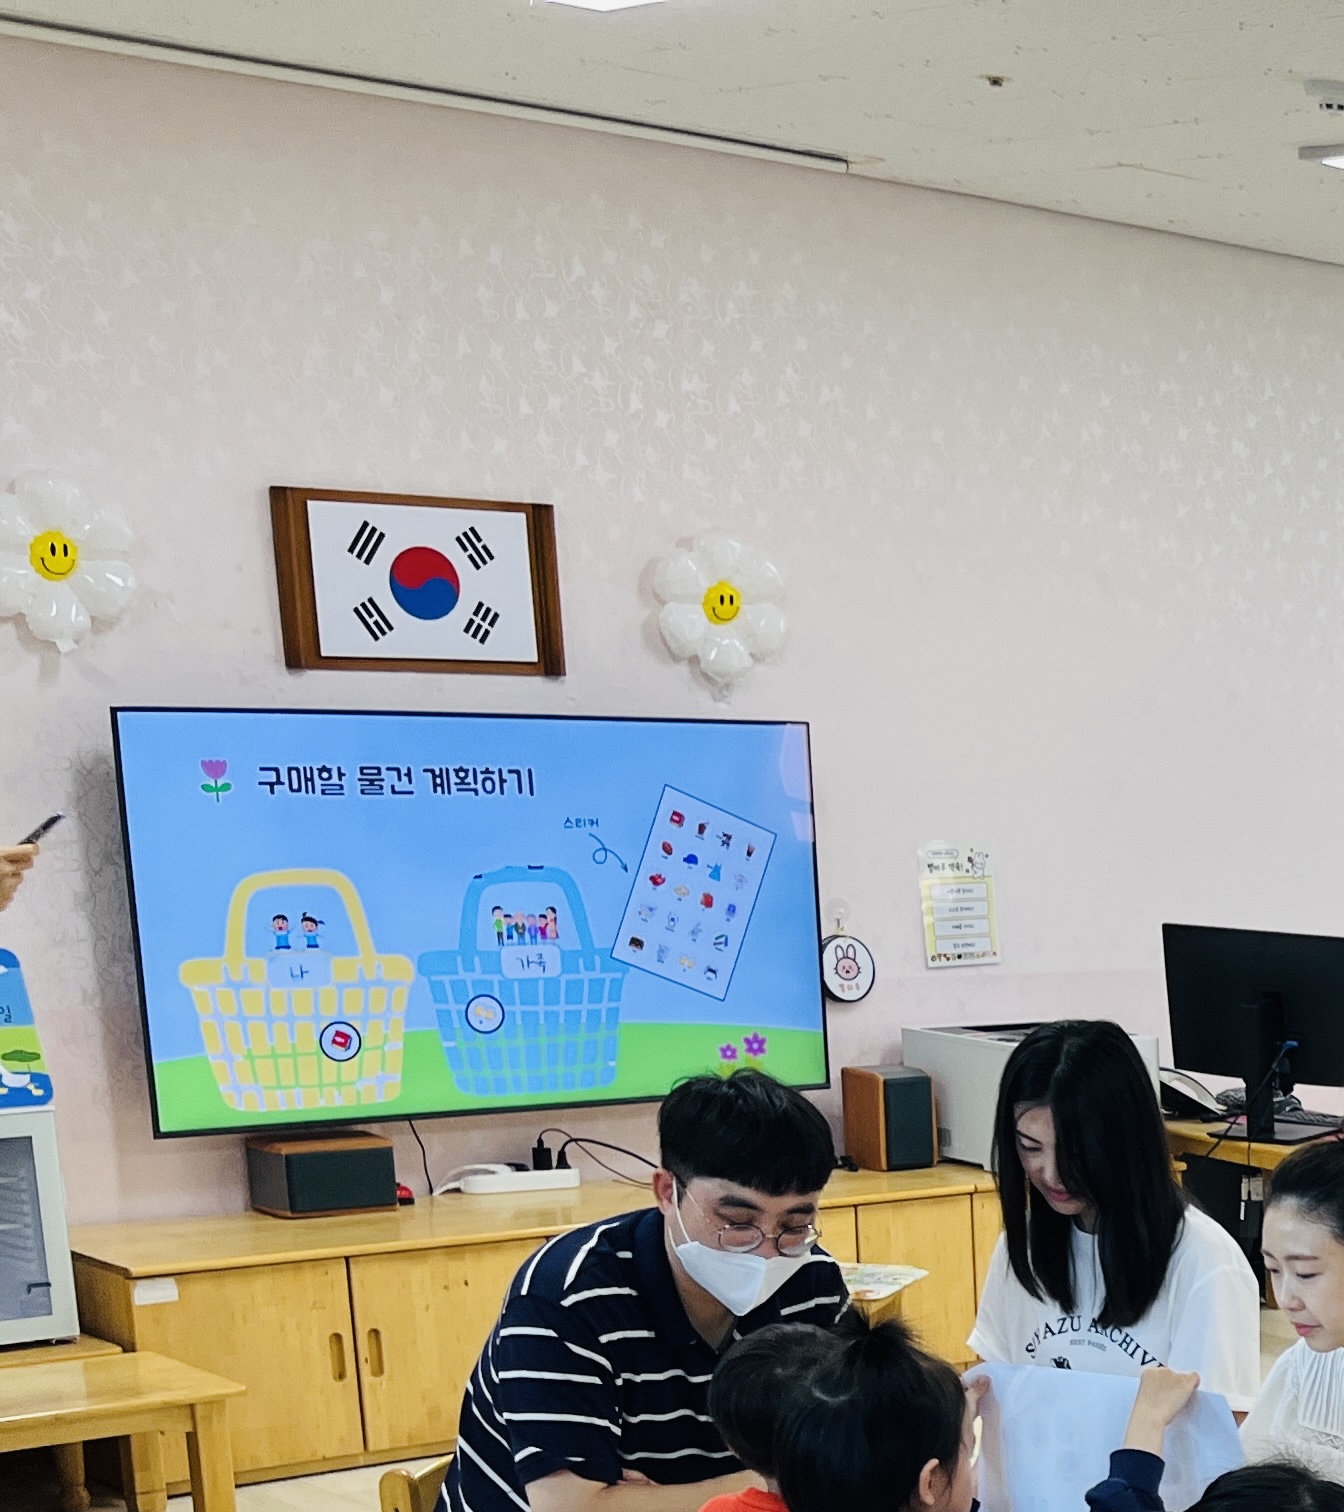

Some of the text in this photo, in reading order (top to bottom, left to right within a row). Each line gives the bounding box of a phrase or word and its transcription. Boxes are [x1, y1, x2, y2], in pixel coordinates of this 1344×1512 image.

[257, 764, 535, 797] 구매할 물건 계획하기
[563, 817, 600, 829] 스티커
[289, 966, 309, 980] 나
[515, 952, 547, 974] 가족
[1087, 1317, 1166, 1368] ARCHIV
